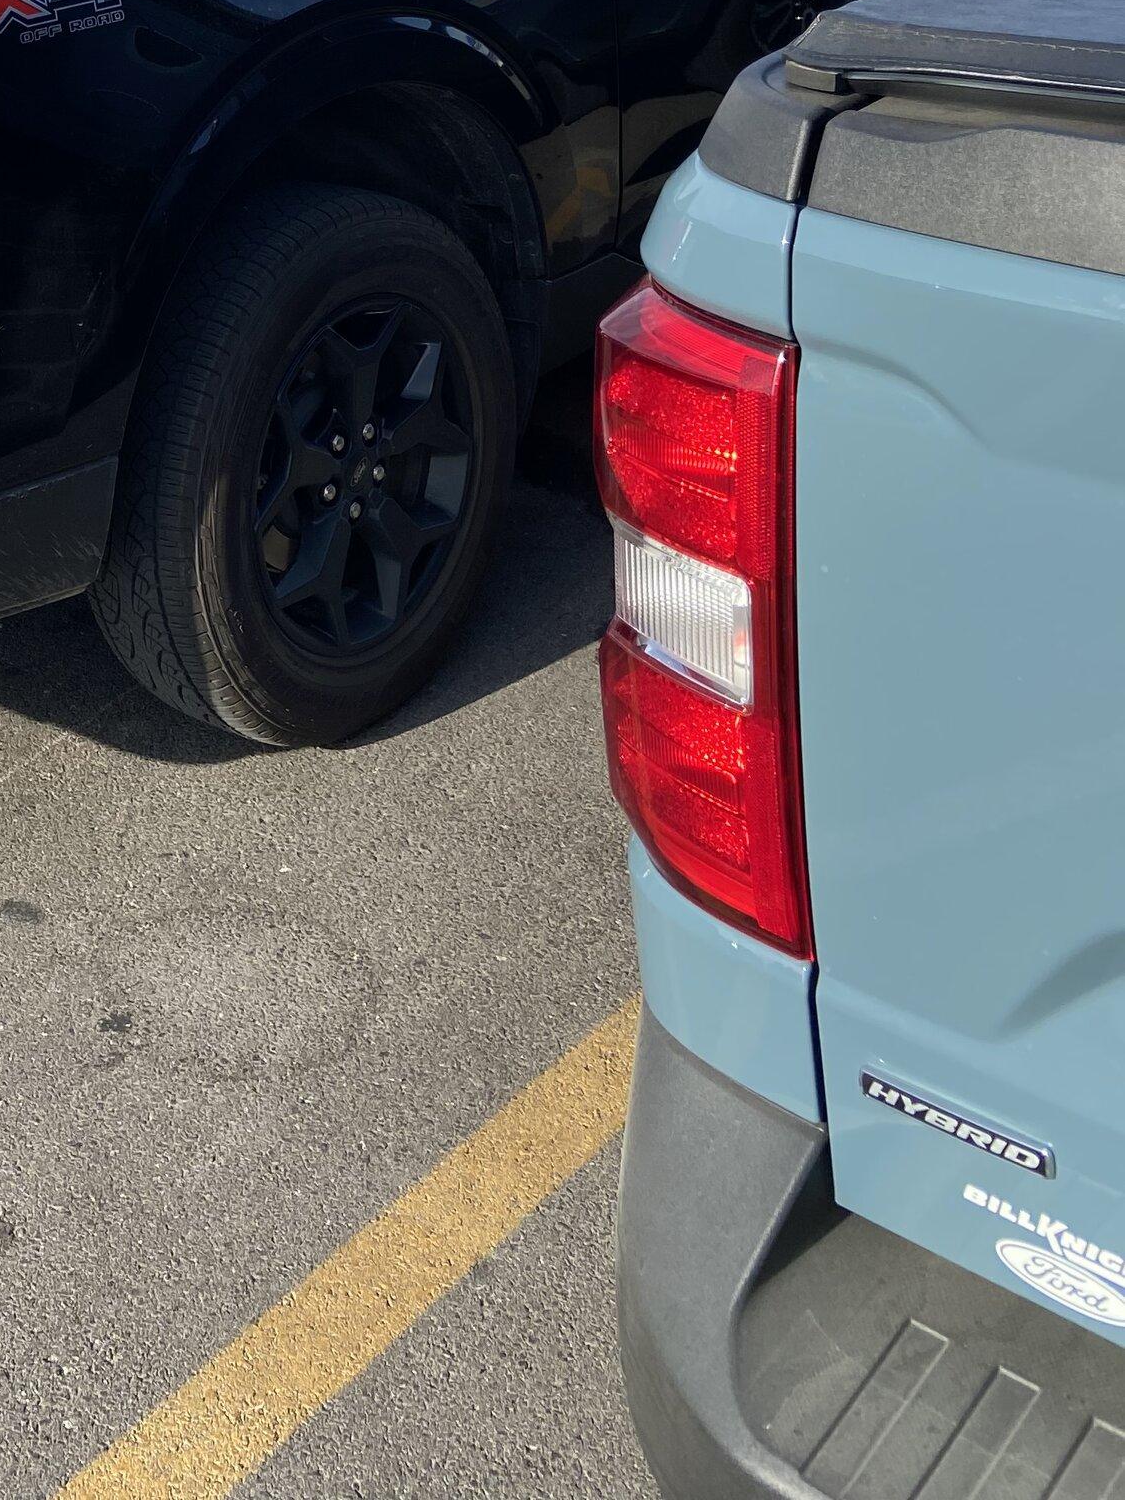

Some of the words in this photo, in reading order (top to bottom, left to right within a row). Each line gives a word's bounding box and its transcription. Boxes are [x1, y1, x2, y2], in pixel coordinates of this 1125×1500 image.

[20, 23, 63, 45] OFF
[70, 10, 125, 33] ROAD
[868, 1081, 1042, 1170] HYBRID
[1024, 1255, 1108, 1313] Ford
